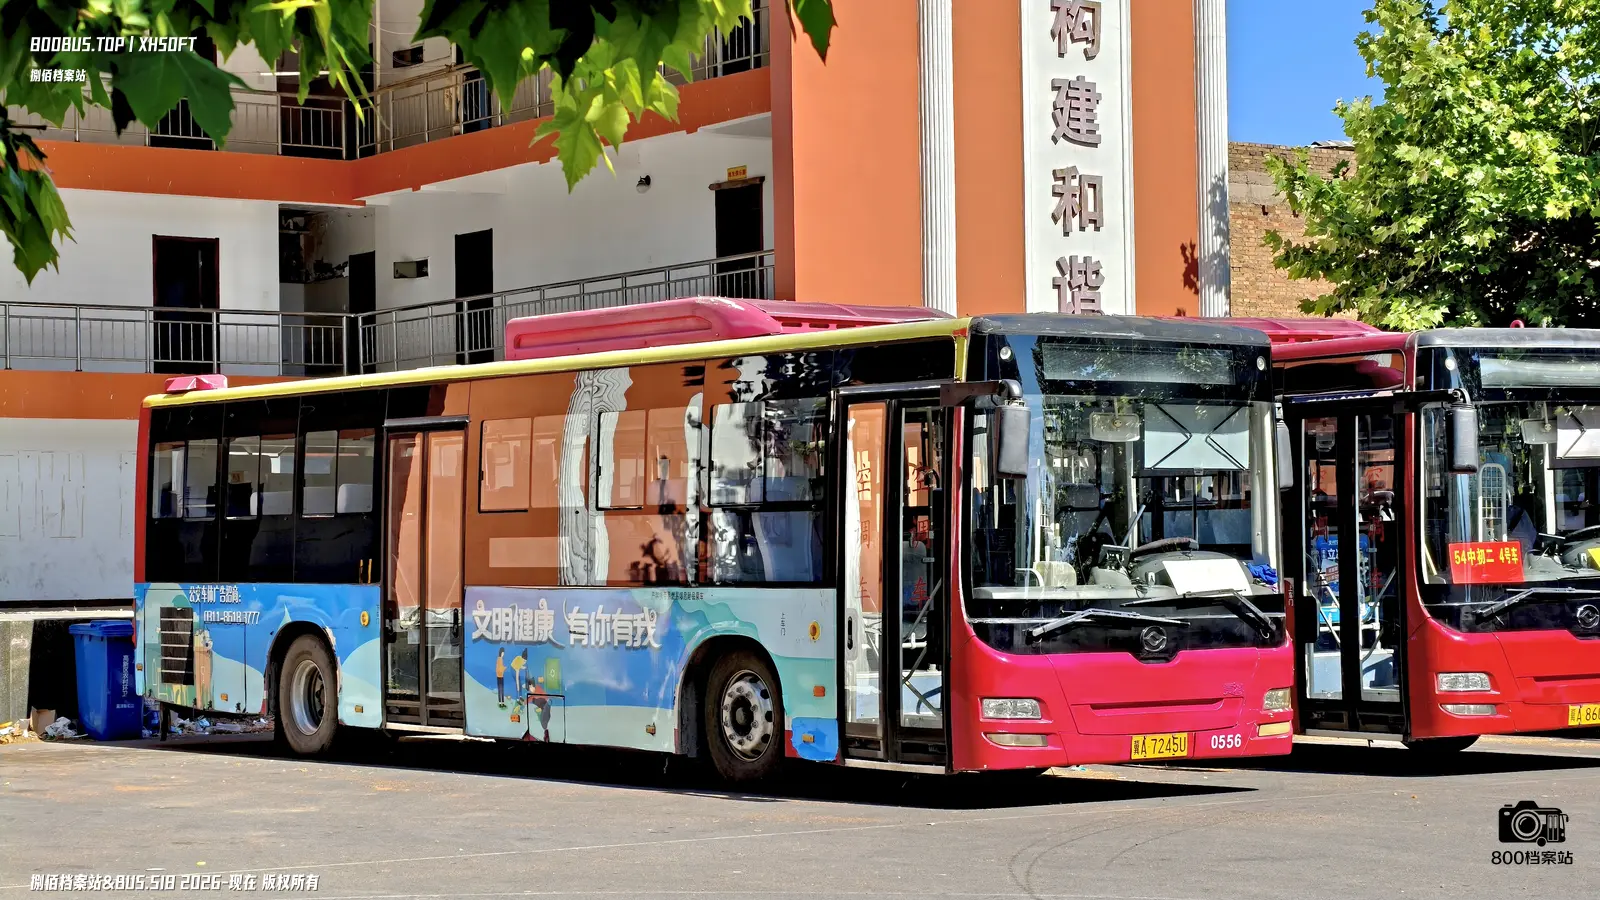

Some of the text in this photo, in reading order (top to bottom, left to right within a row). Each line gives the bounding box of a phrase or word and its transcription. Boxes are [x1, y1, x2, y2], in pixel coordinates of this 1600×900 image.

[1050, 0, 1105, 315] 构建和谐
[1454, 547, 1519, 565] 54中初二 4号车
[472, 598, 662, 649] 文明健康 有你有我
[1211, 734, 1242, 749] 0556
